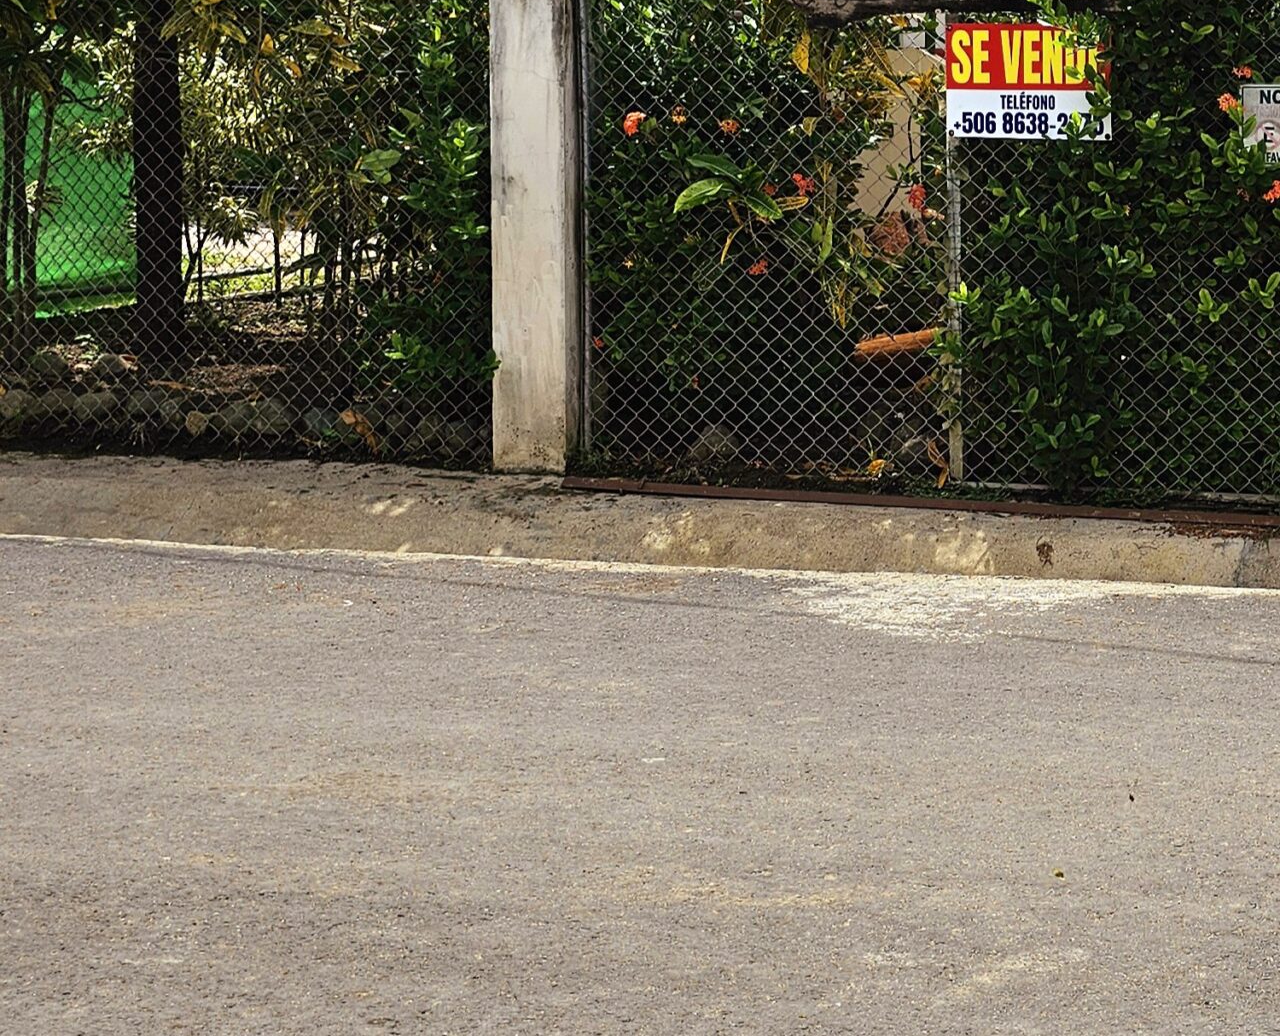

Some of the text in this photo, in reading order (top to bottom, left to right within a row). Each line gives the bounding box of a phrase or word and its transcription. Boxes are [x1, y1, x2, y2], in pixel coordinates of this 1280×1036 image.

[951, 29, 991, 84] SE
[1000, 91, 1056, 110] TELÉFONO
[953, 112, 1104, 136] +506 8638-27
